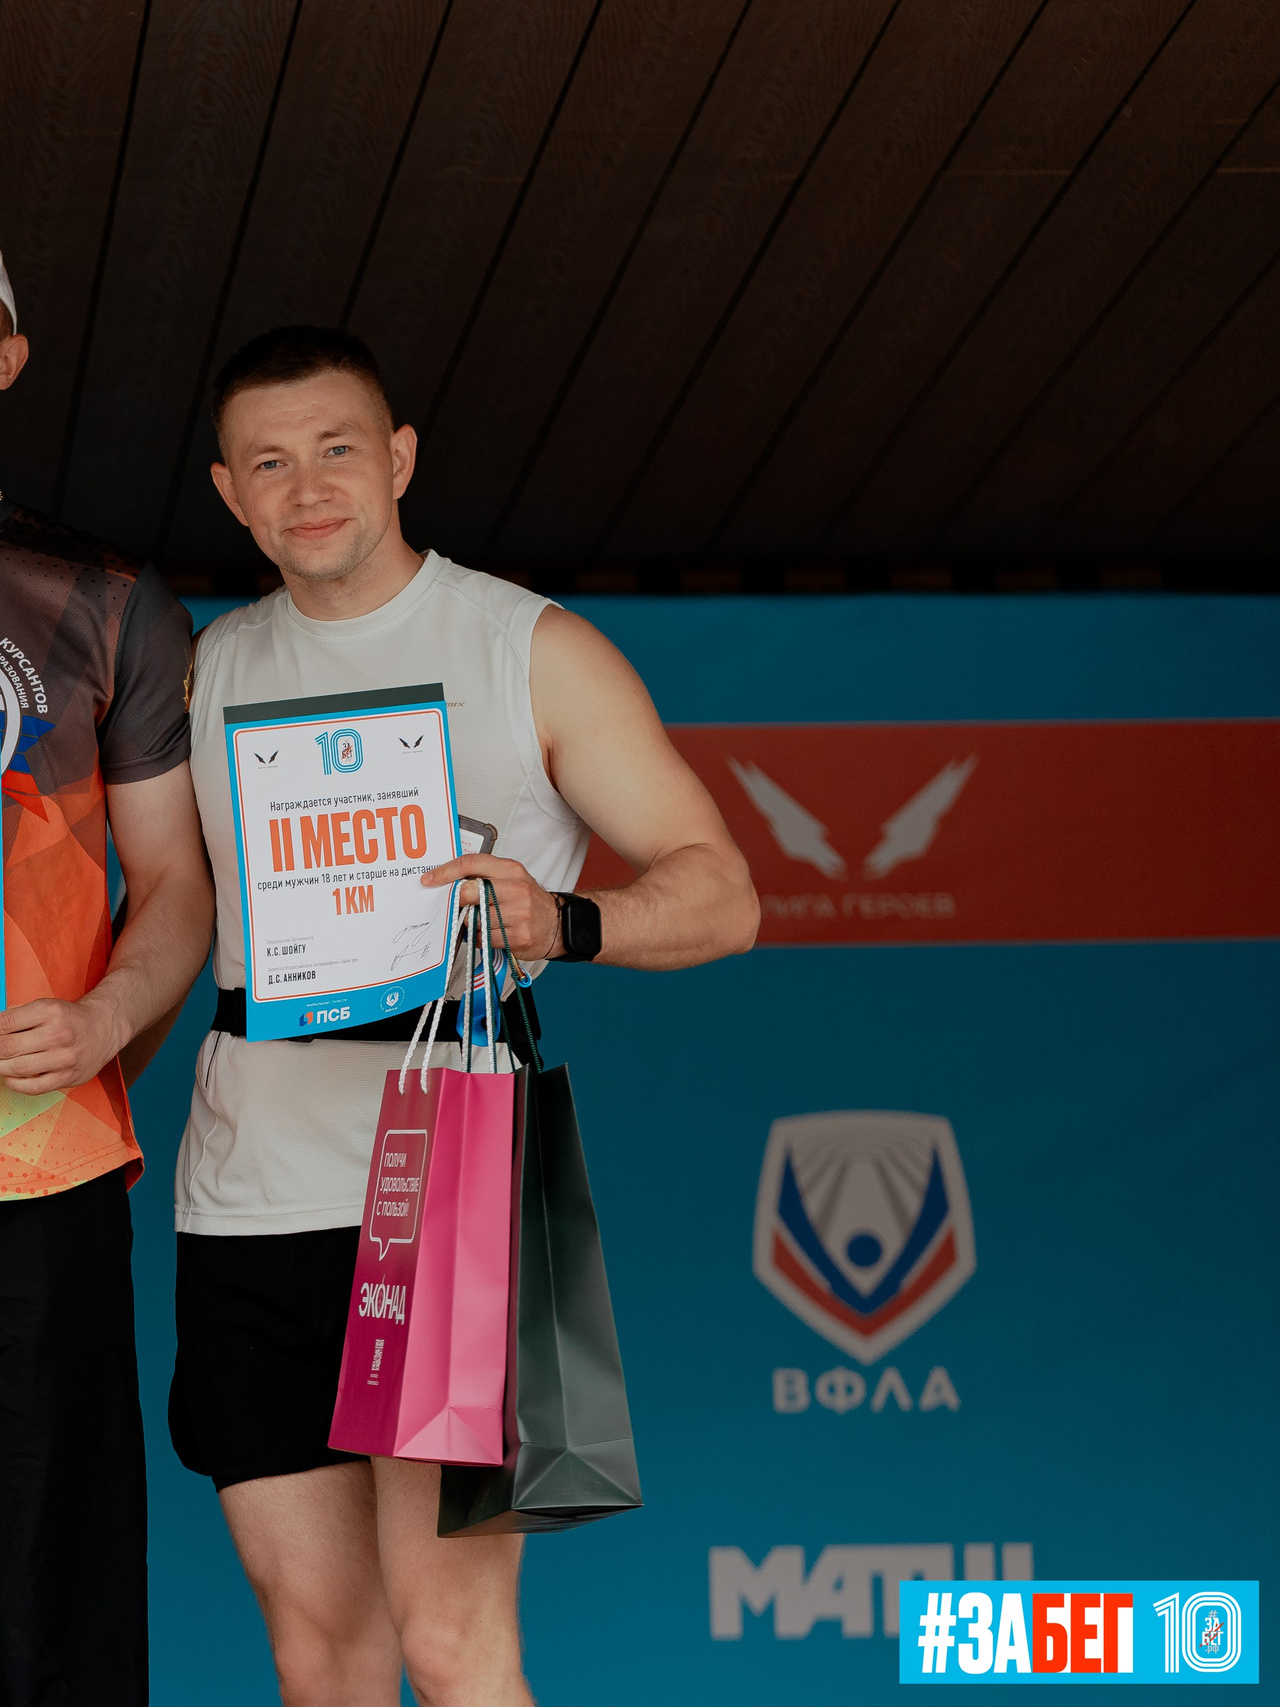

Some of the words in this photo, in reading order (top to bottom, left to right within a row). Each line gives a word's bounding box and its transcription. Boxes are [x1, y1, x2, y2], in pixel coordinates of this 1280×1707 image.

[0, 637, 48, 714] КУРСАНТОВ
[314, 728, 364, 775] 10
[270, 797, 332, 812] Награждается
[333, 794, 375, 807] участник,
[377, 787, 419, 801] занявший
[269, 817, 295, 872] II
[299, 804, 428, 869] МЕСТО
[257, 880, 283, 892] среди
[285, 877, 319, 889] мужчин
[321, 873, 331, 884] 18
[332, 874, 347, 883] лет
[349, 873, 355, 881] и
[356, 870, 387, 881] старше
[389, 868, 399, 877] на
[332, 888, 341, 915] 1
[345, 885, 375, 914] КМ
[266, 946, 281, 957] К.С.
[282, 943, 306, 955] ШОЙГУ
[268, 974, 282, 985] Д.С.
[283, 970, 316, 982] АННИКОВ
[316, 1006, 351, 1024] ПСБ
[358, 1282, 407, 1326] ЭКОНАД
[771, 1365, 962, 1414] ВФЛА
